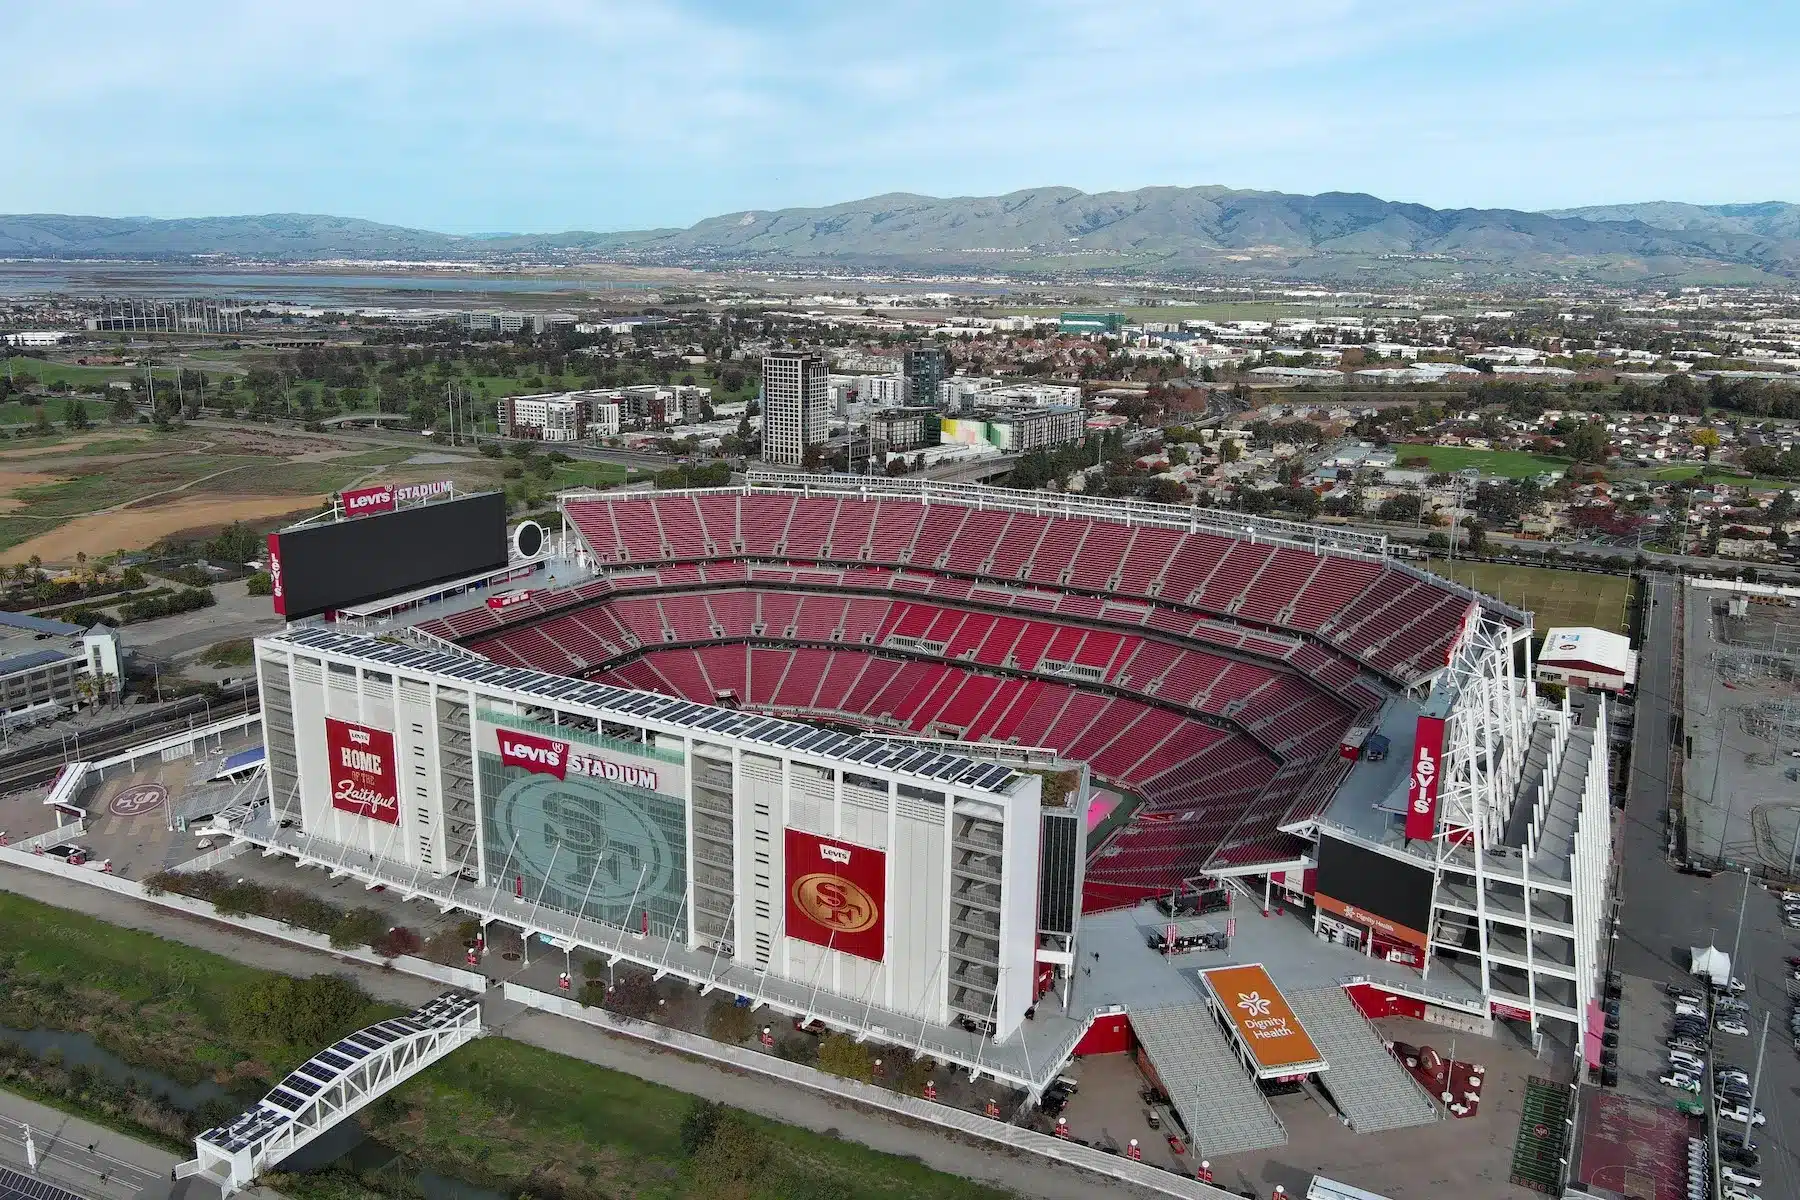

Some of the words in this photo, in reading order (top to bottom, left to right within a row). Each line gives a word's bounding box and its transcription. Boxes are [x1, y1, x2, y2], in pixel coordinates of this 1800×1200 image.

[398, 480, 452, 500] STADIUM
[341, 746, 382, 776] HOME
[570, 754, 657, 791] STADIUM
[334, 779, 397, 814] Faithful
[1356, 912, 1375, 926] Dignity
[1375, 920, 1394, 932] Health
[1244, 1017, 1286, 1030] Dignity
[1252, 1026, 1294, 1039] Health
